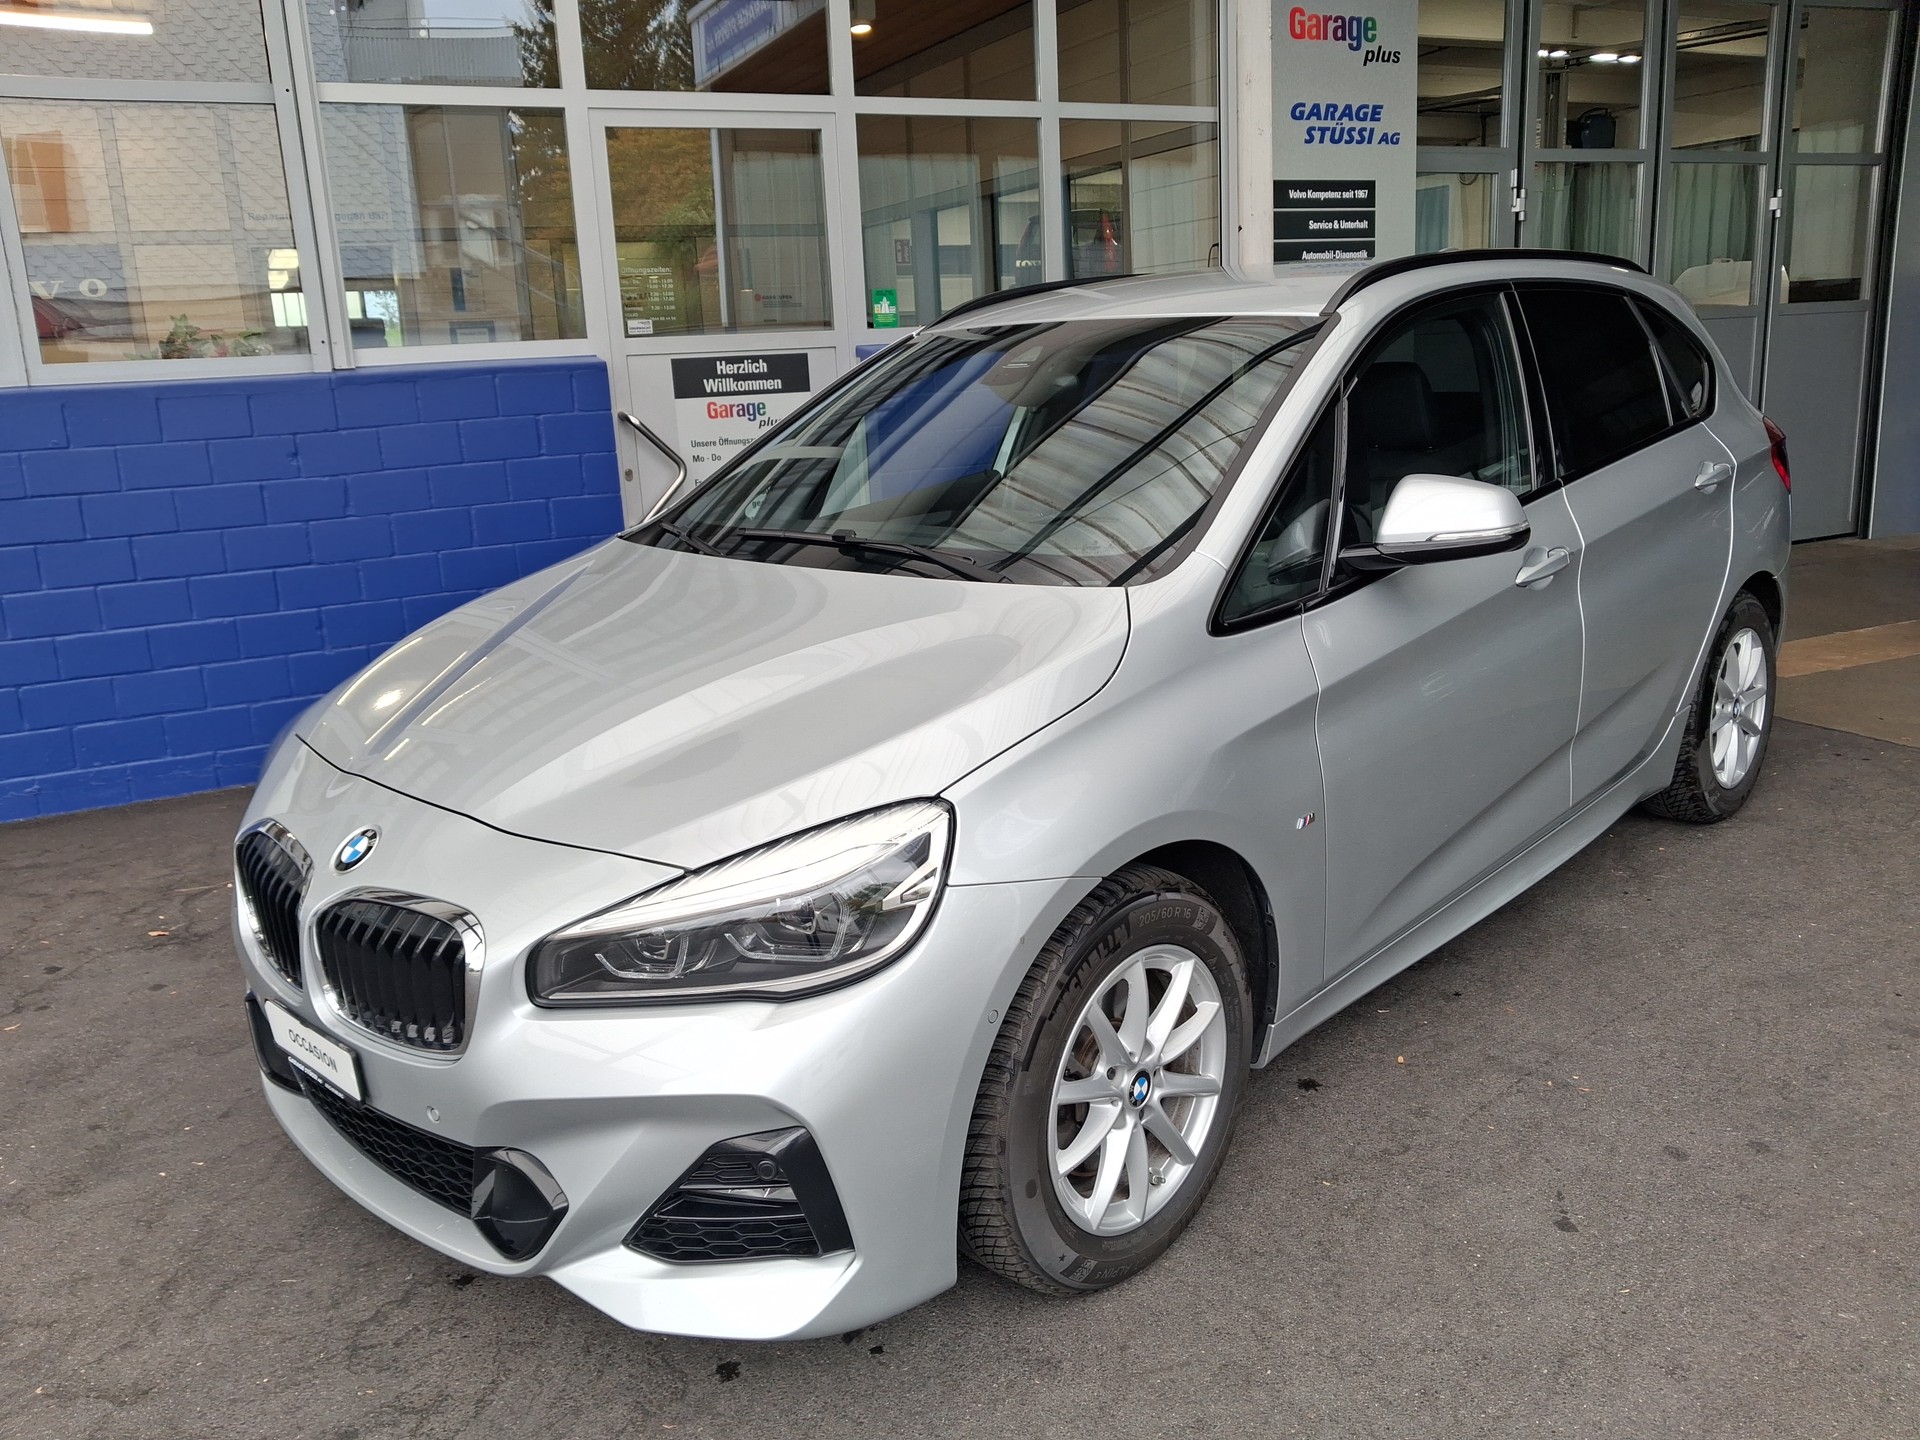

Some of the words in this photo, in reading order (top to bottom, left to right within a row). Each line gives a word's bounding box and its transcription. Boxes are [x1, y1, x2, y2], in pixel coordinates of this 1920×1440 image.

[1289, 6, 1377, 52] Garage
[1363, 45, 1401, 67] plus
[1290, 102, 1384, 122] GARAGE
[1304, 122, 1375, 145] STÜSSI
[1377, 132, 1400, 145] AG
[1288, 189, 1307, 199] Volvo
[1307, 189, 1342, 201] Kompetenz
[1342, 189, 1354, 199] seit
[1354, 189, 1369, 199] 1967
[1308, 220, 1333, 230] Service
[1333, 220, 1340, 229] &
[1340, 220, 1369, 229] Unterhalt
[1302, 249, 1368, 260] Automobil-Diagnostik
[716, 359, 768, 375] Herzlich
[703, 377, 783, 393] Willkommen
[706, 401, 767, 422] Garage
[690, 439, 717, 448] Unsere
[718, 435, 758, 446] Öffnungsz
[692, 454, 705, 463] Mo
[711, 453, 722, 461] Do
[1139, 906, 1173, 927] 205/60
[1174, 906, 1181, 918] R
[1182, 907, 1192, 919] 16
[288, 1028, 338, 1073] OCCASION
